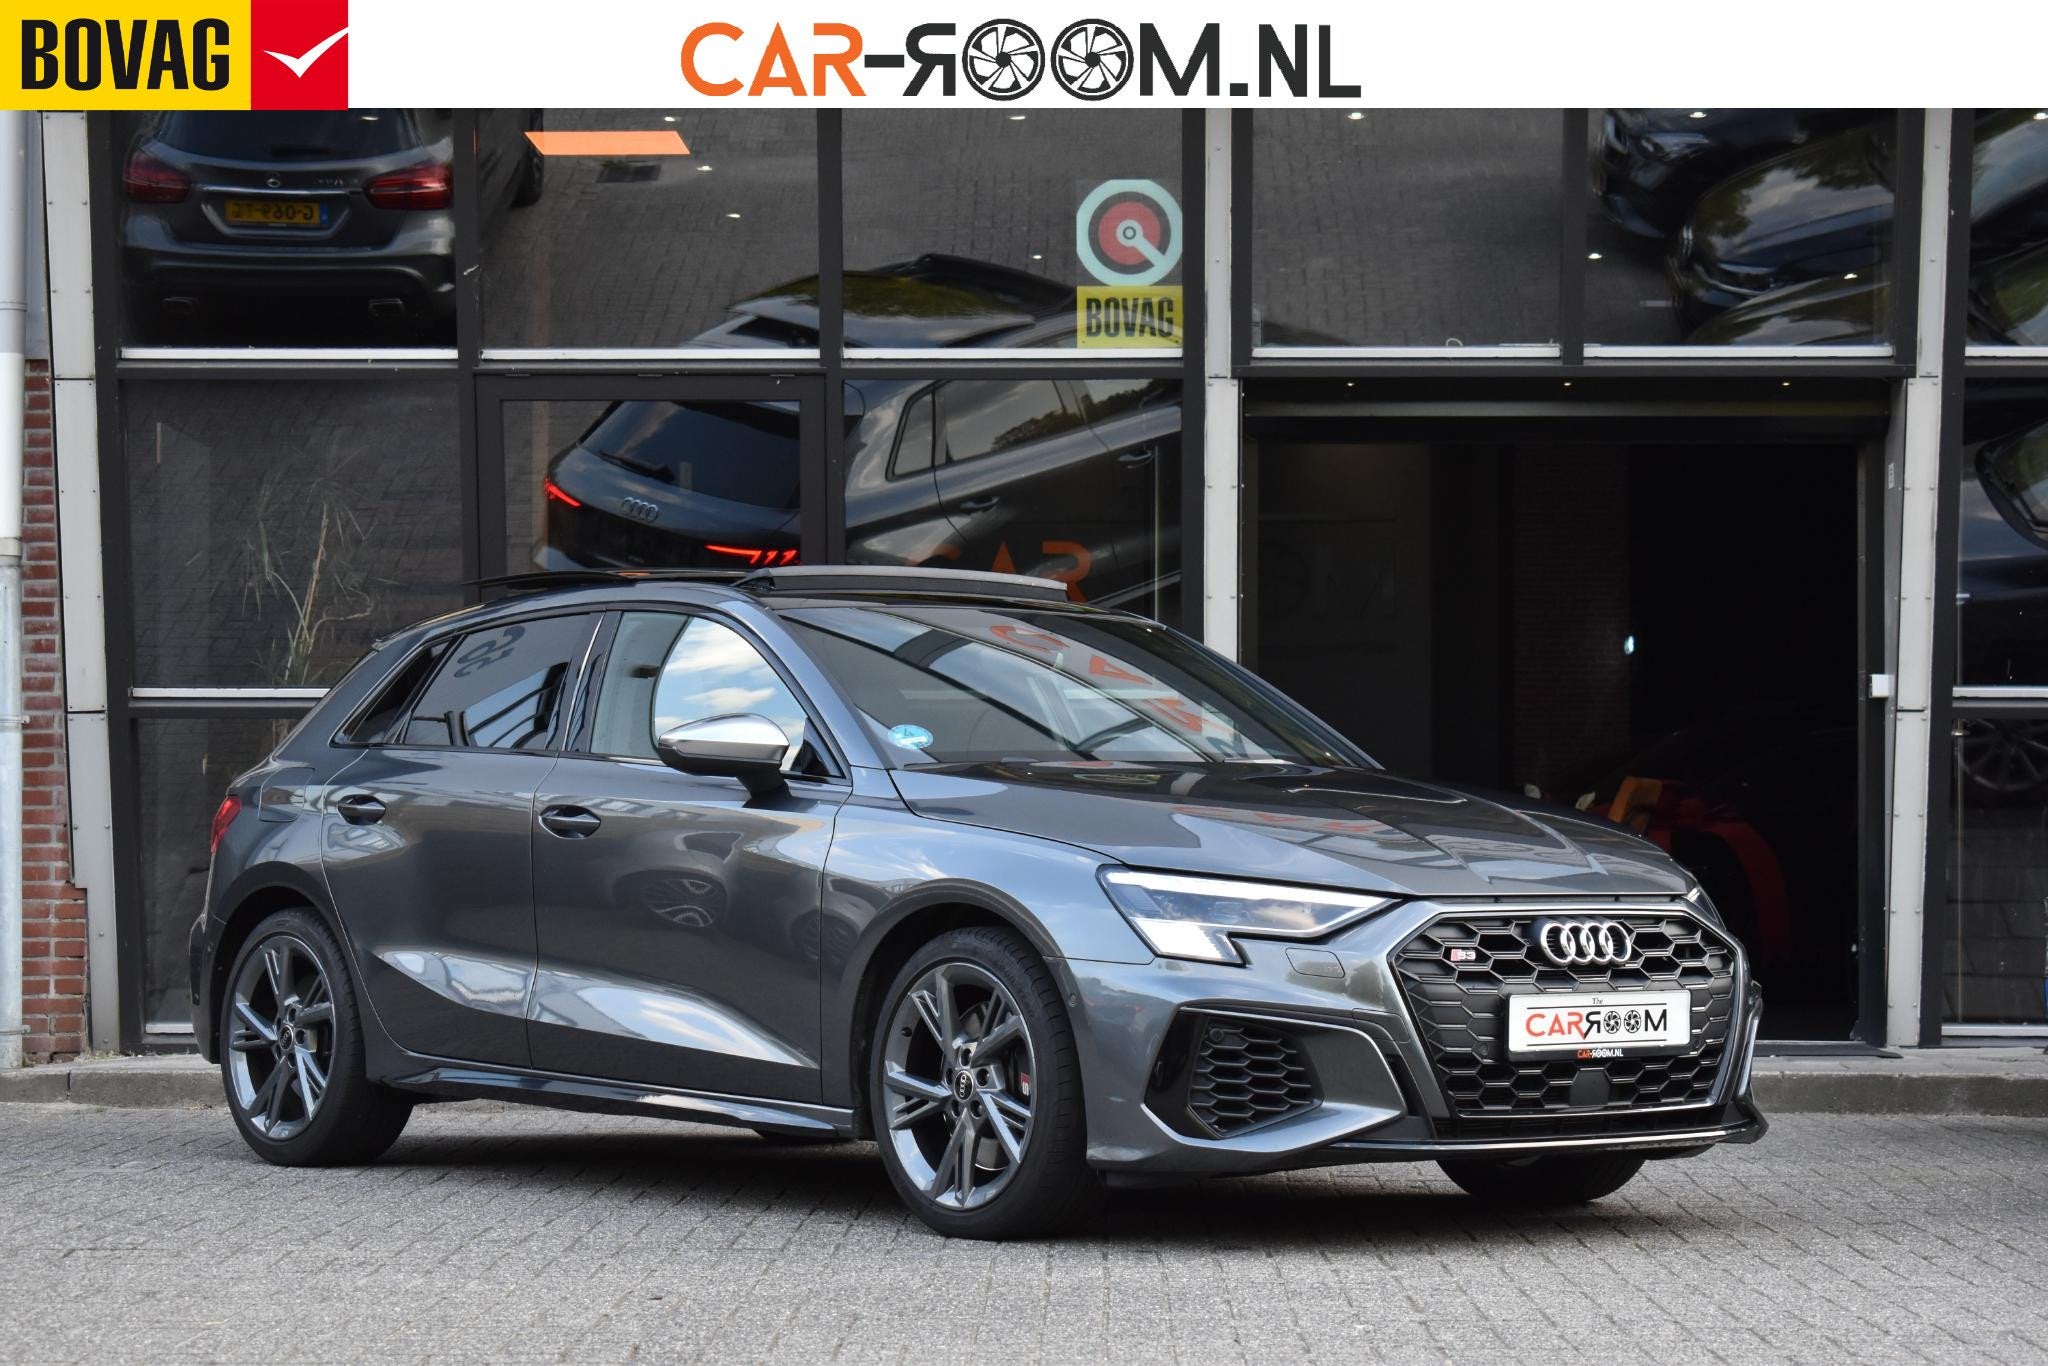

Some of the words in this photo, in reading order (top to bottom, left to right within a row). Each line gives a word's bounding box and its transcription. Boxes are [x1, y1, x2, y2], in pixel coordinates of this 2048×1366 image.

[1086, 296, 1174, 338] BOVAG
[1455, 950, 1476, 960] S3
[1592, 997, 1604, 1005] The
